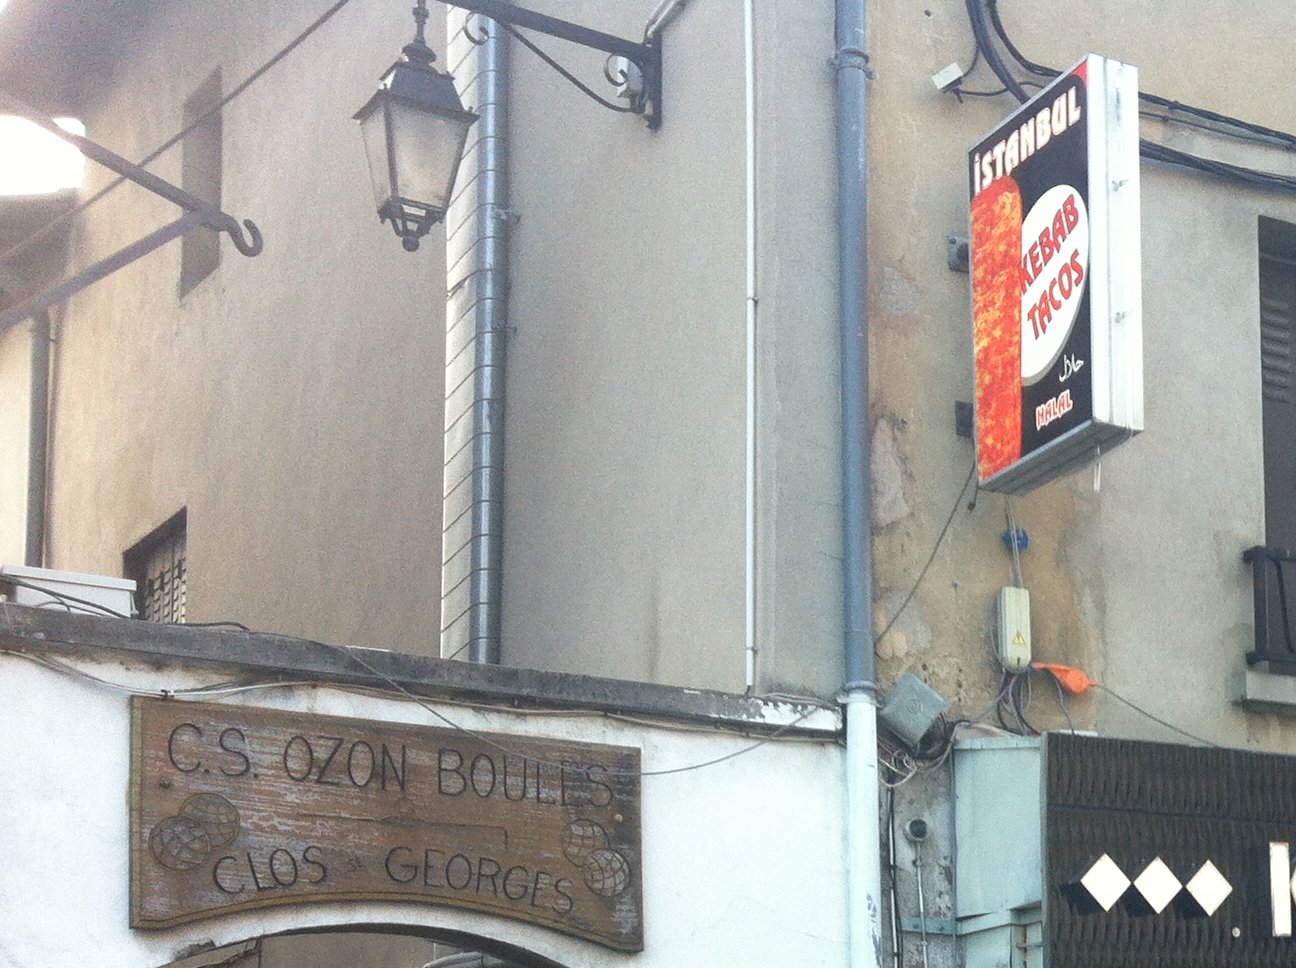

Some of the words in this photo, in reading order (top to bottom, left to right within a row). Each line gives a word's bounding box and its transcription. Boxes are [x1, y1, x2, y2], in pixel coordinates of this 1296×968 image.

[1019, 194, 1079, 294] KEBAB
[1027, 250, 1084, 339] TACOS
[1035, 389, 1073, 431] HALAL
[282, 735, 407, 791] OZON
[438, 748, 614, 808] BOULES
[212, 845, 327, 896] CLOS
[384, 846, 574, 914] GEORGES
